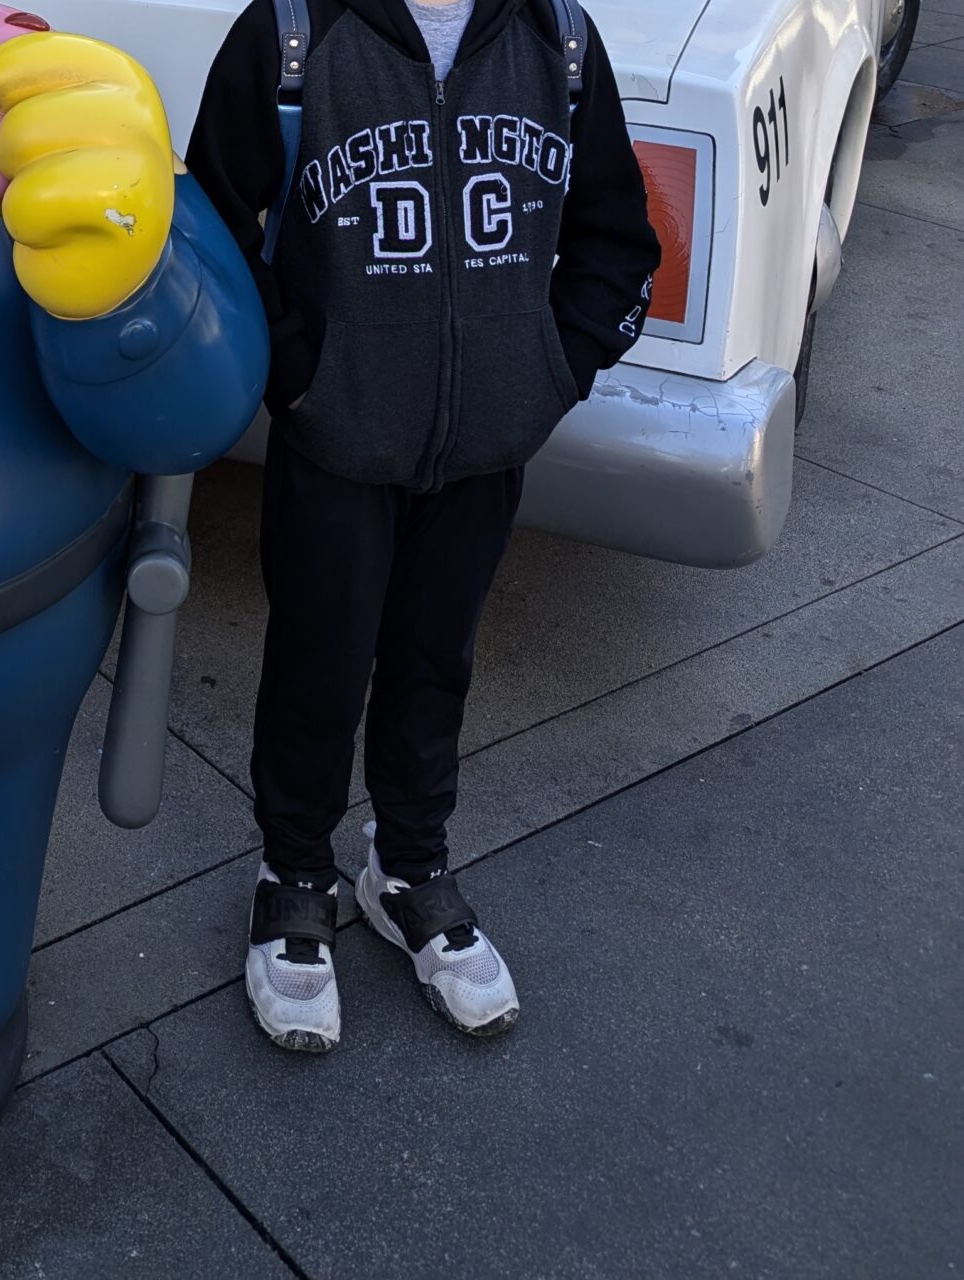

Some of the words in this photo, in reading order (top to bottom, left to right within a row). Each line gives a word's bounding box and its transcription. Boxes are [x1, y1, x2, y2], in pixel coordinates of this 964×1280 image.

[752, 75, 790, 208] 911
[338, 217, 360, 226] EST
[369, 180, 433, 258] D
[462, 172, 513, 253] C
[365, 264, 407, 275] UNITED
[489, 252, 529, 266] CAPITAL
